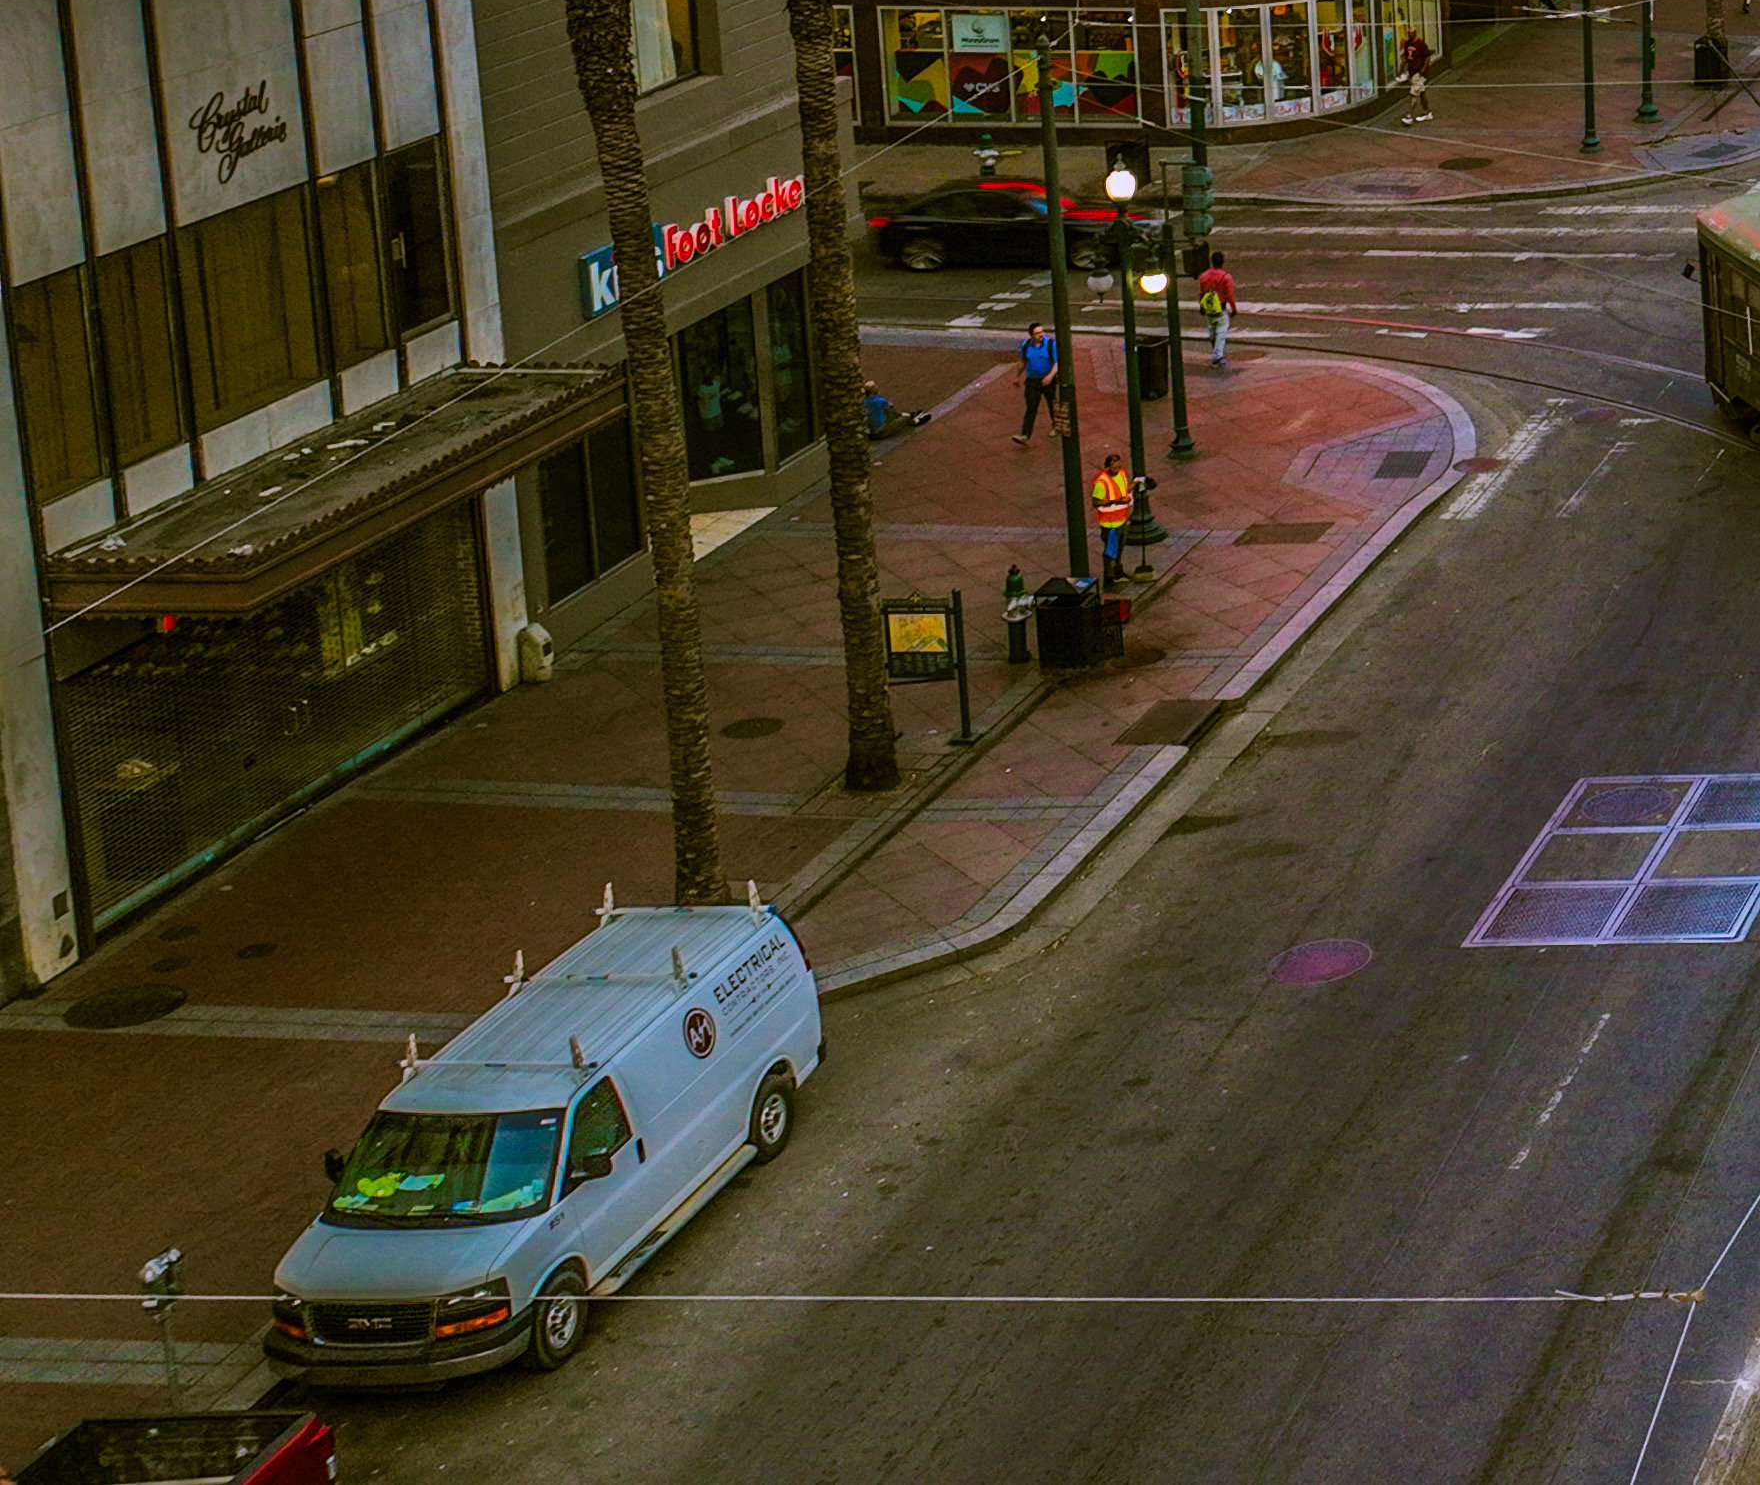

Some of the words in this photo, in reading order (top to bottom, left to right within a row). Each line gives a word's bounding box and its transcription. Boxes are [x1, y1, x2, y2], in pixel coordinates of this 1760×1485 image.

[189, 80, 269, 153] Crystal
[665, 207, 724, 270] Foot
[725, 175, 805, 238] Locke
[713, 935, 785, 1003] ELECTRICAL
